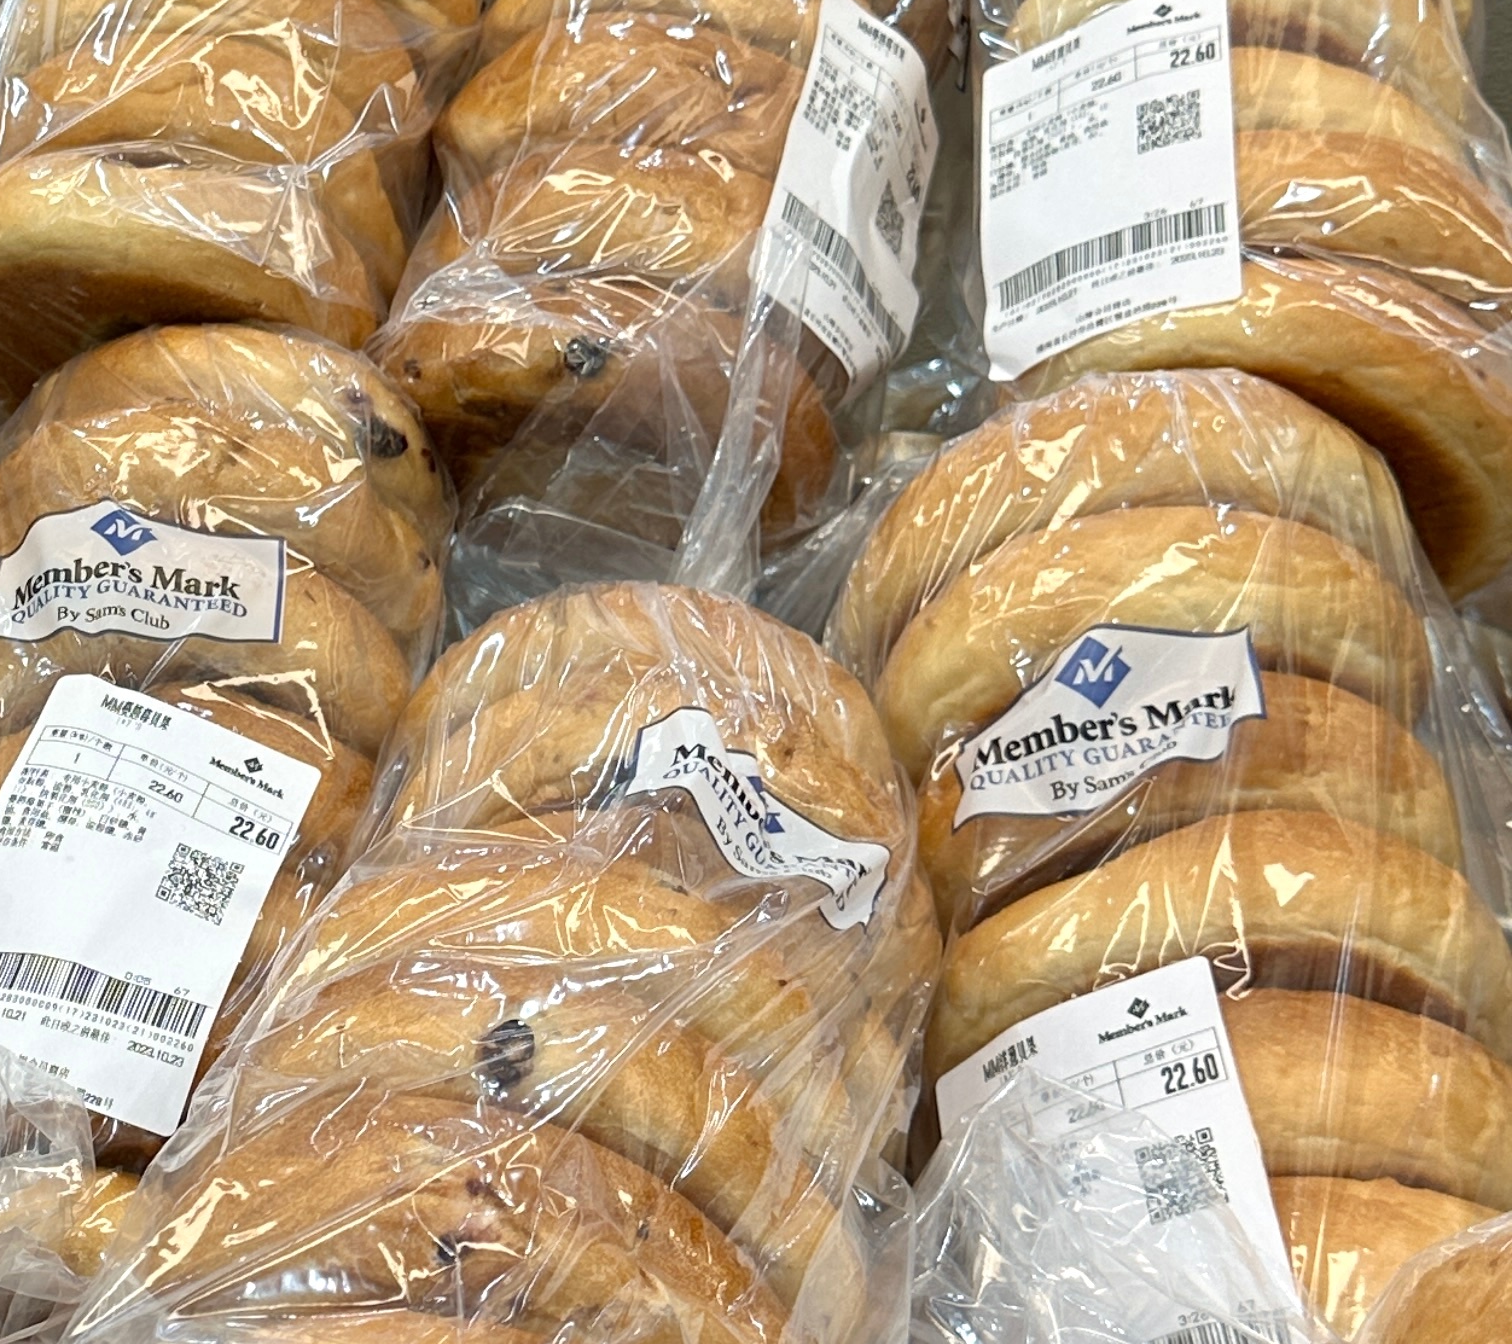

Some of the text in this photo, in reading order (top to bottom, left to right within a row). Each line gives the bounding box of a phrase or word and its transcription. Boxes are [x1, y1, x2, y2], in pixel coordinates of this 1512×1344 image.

[1170, 42, 1216, 69] 22.60
[11, 557, 241, 611] Member's Mark
[11, 579, 248, 624] QUALITY GUARANTEED
[57, 604, 170, 630] By Sam's Club
[972, 713, 1138, 773] Member's
[209, 755, 285, 800] Member's Mark
[970, 748, 1076, 790] QUALITY
[1050, 769, 1136, 801] By Sam's
[148, 779, 184, 803] 22.60
[228, 815, 280, 851] 22.60
[717, 817, 732, 845] By
[173, 986, 191, 997] 67
[1098, 1006, 1188, 1044] Member's Mark
[127, 1040, 185, 1068] 2023.10.23
[1160, 1053, 1220, 1095] 22.60
